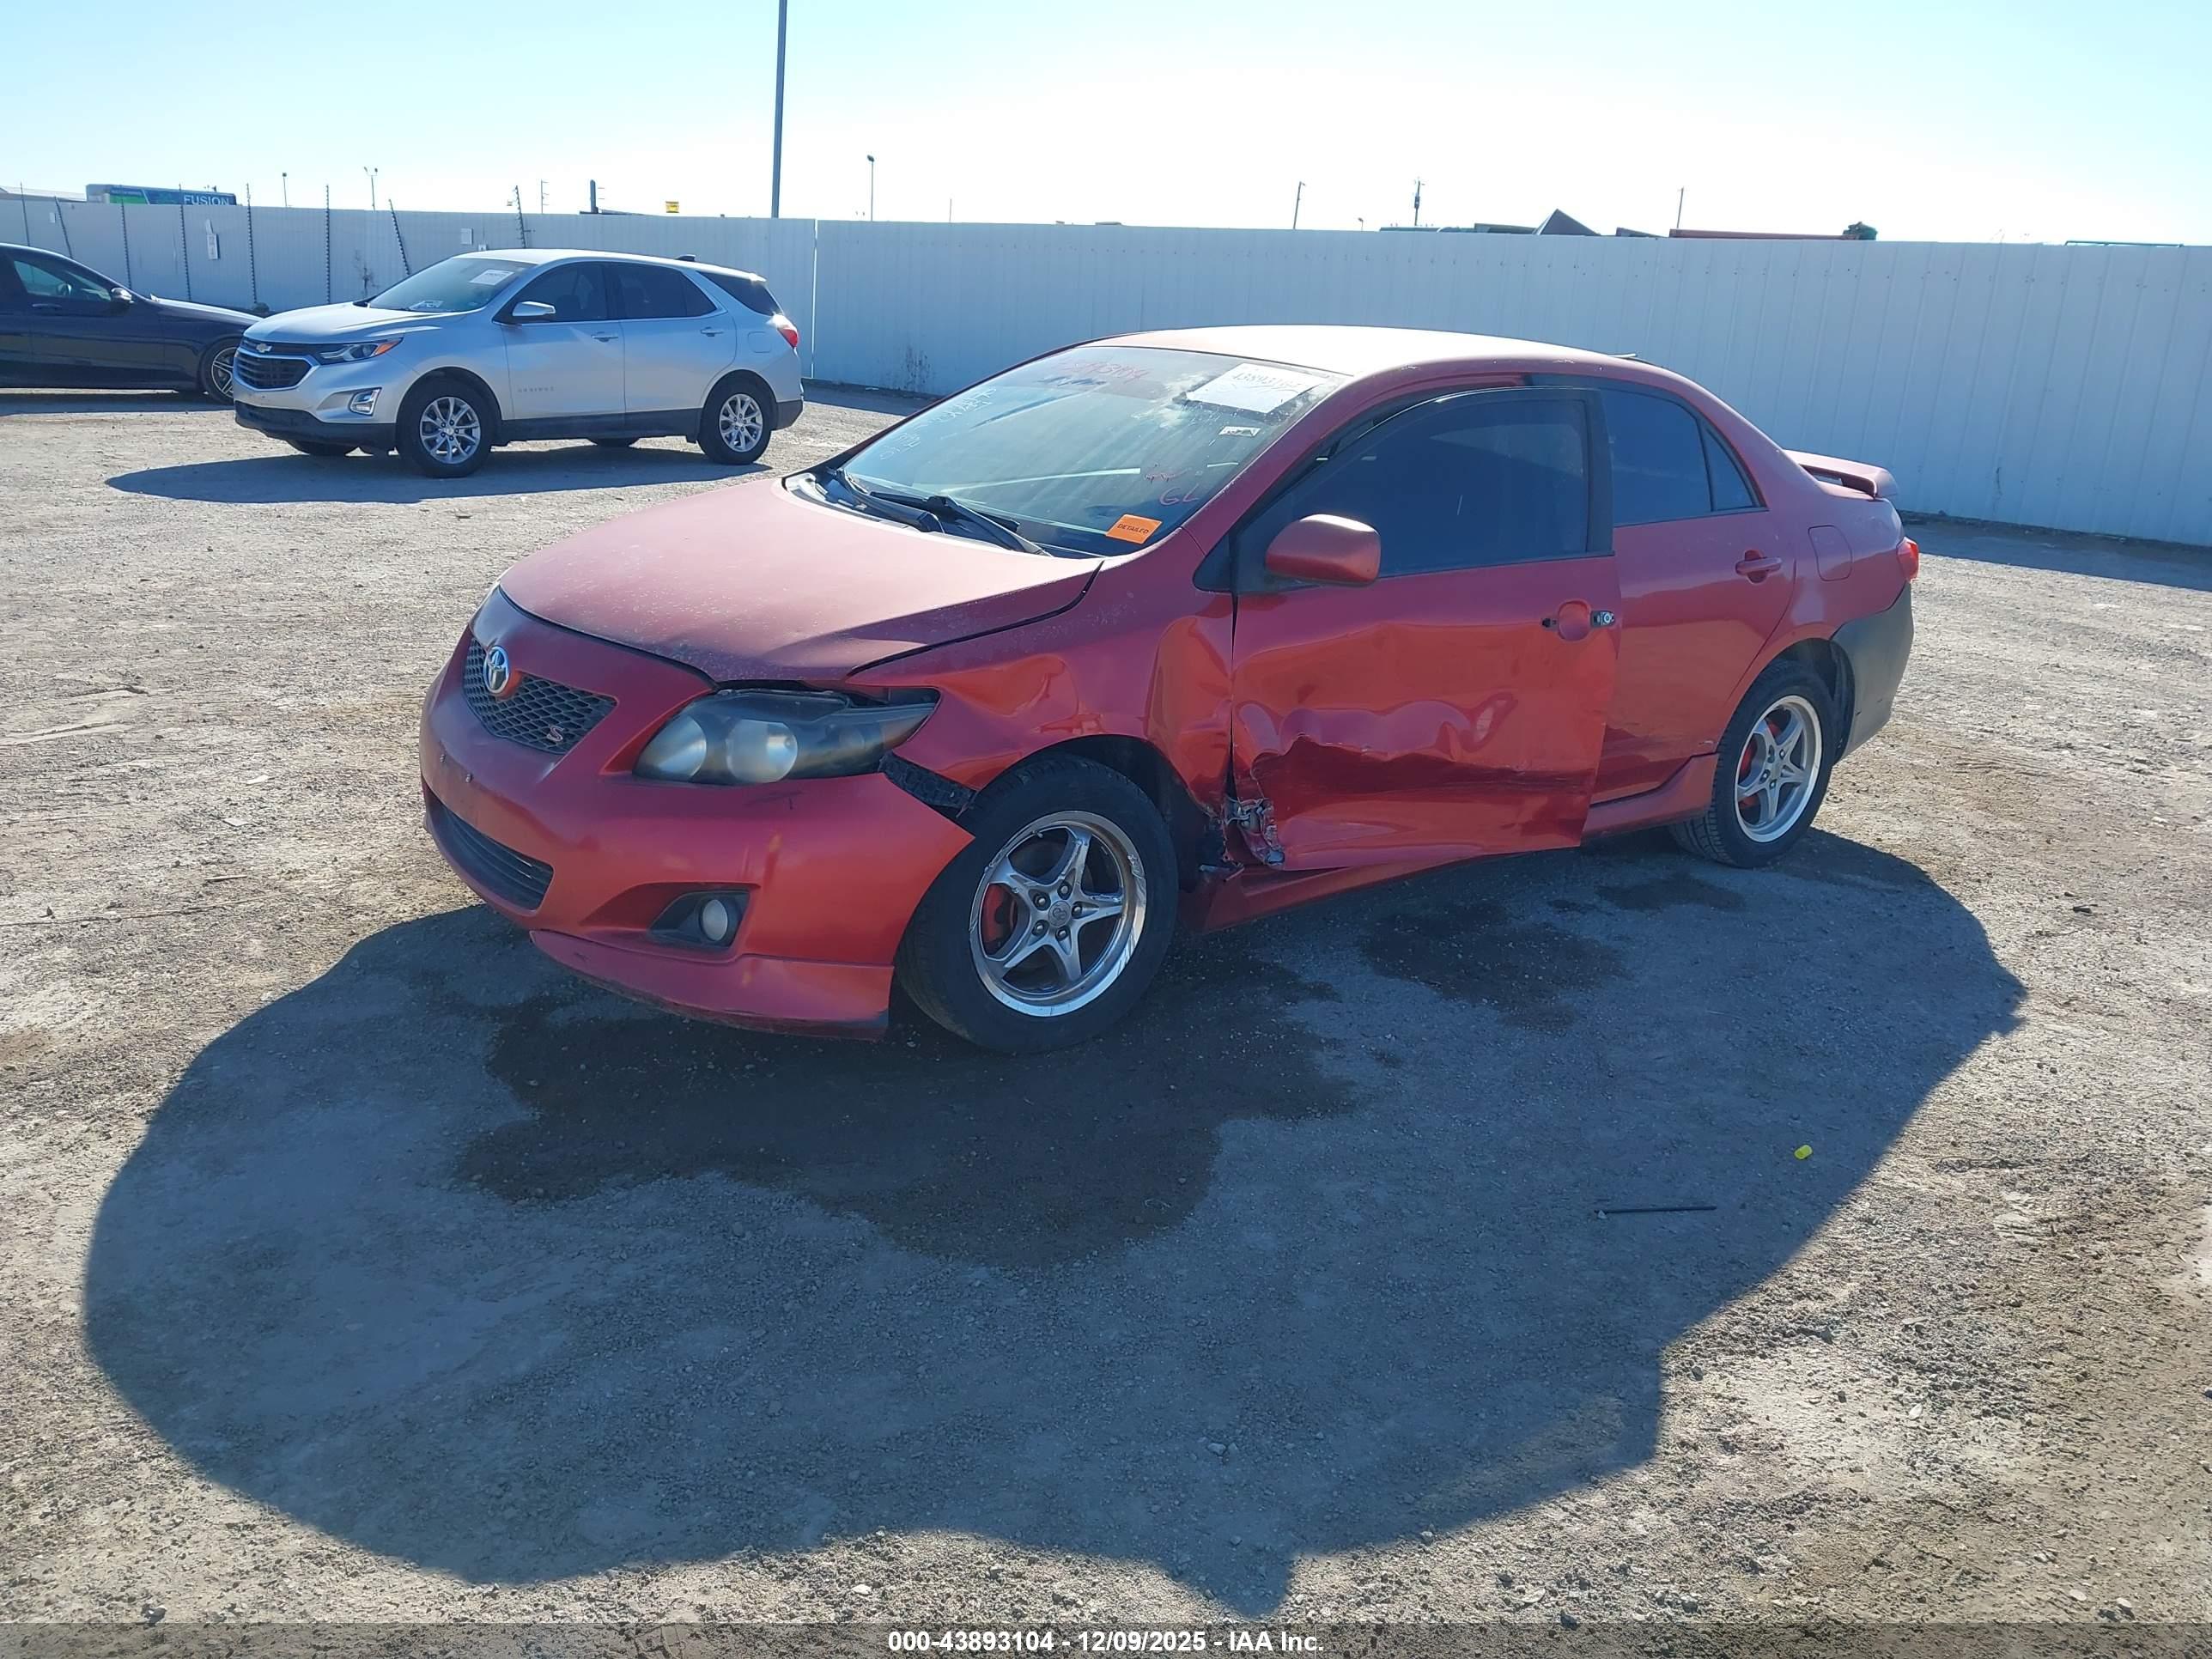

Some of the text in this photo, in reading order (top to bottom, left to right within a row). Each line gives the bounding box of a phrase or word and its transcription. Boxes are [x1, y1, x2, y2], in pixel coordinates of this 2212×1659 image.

[184, 194, 230, 205] FUSION
[1116, 523, 1149, 534] DETAILED
[546, 725, 565, 743] S
